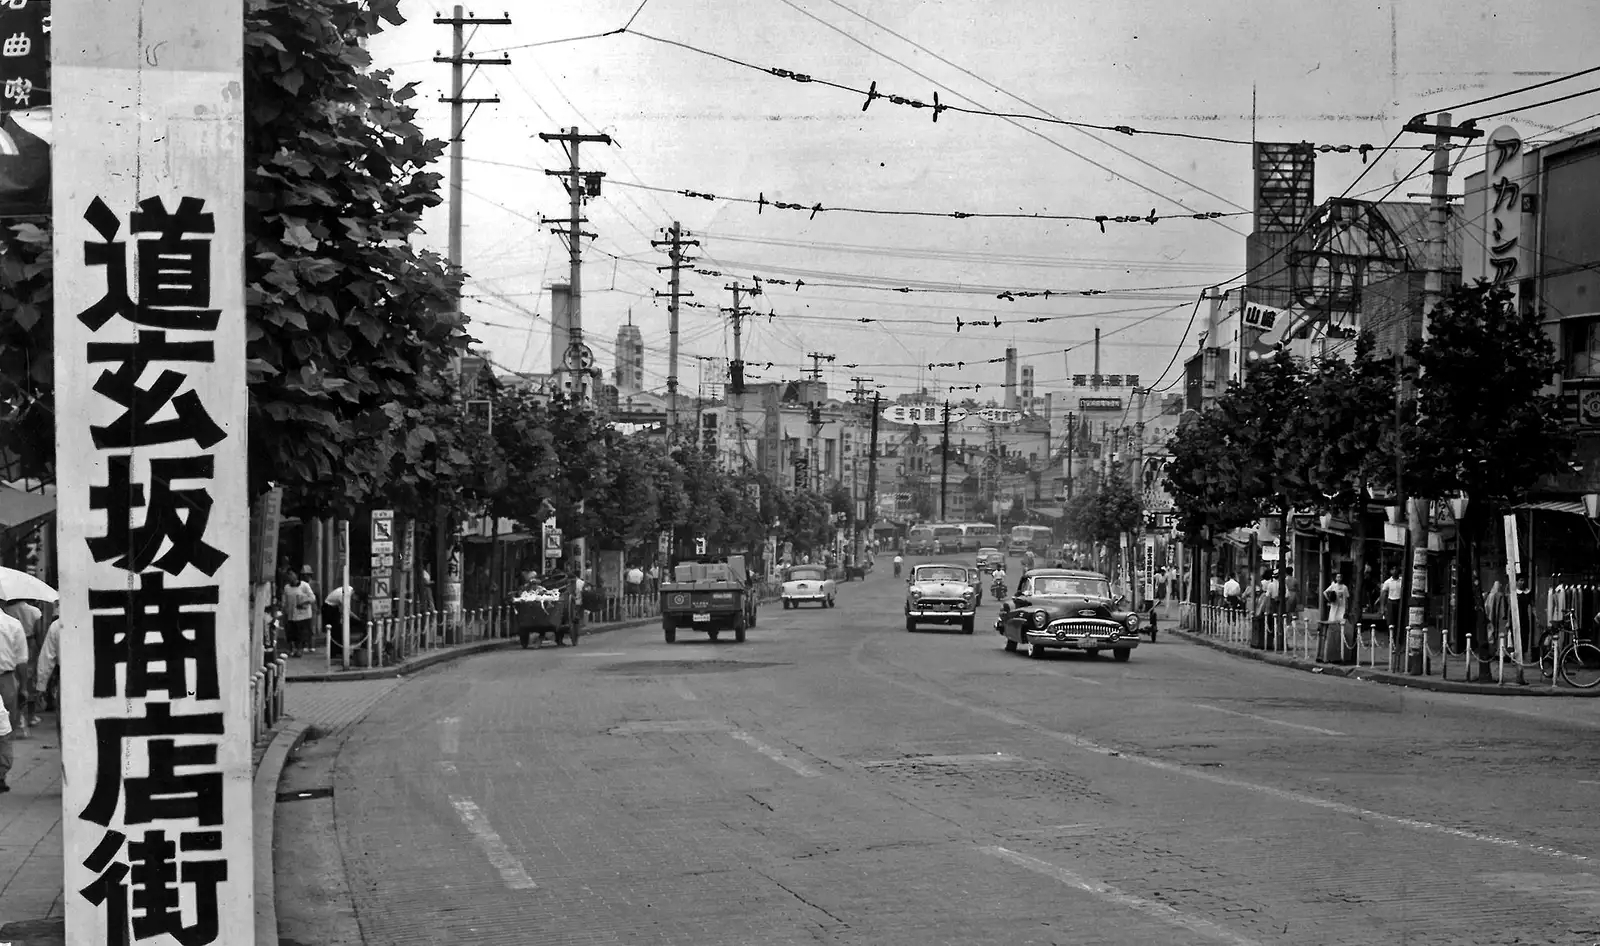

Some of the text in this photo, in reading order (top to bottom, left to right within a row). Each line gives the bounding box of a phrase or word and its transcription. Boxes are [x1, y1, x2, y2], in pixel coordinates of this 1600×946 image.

[77, 196, 228, 945] 道玄坂商店街
